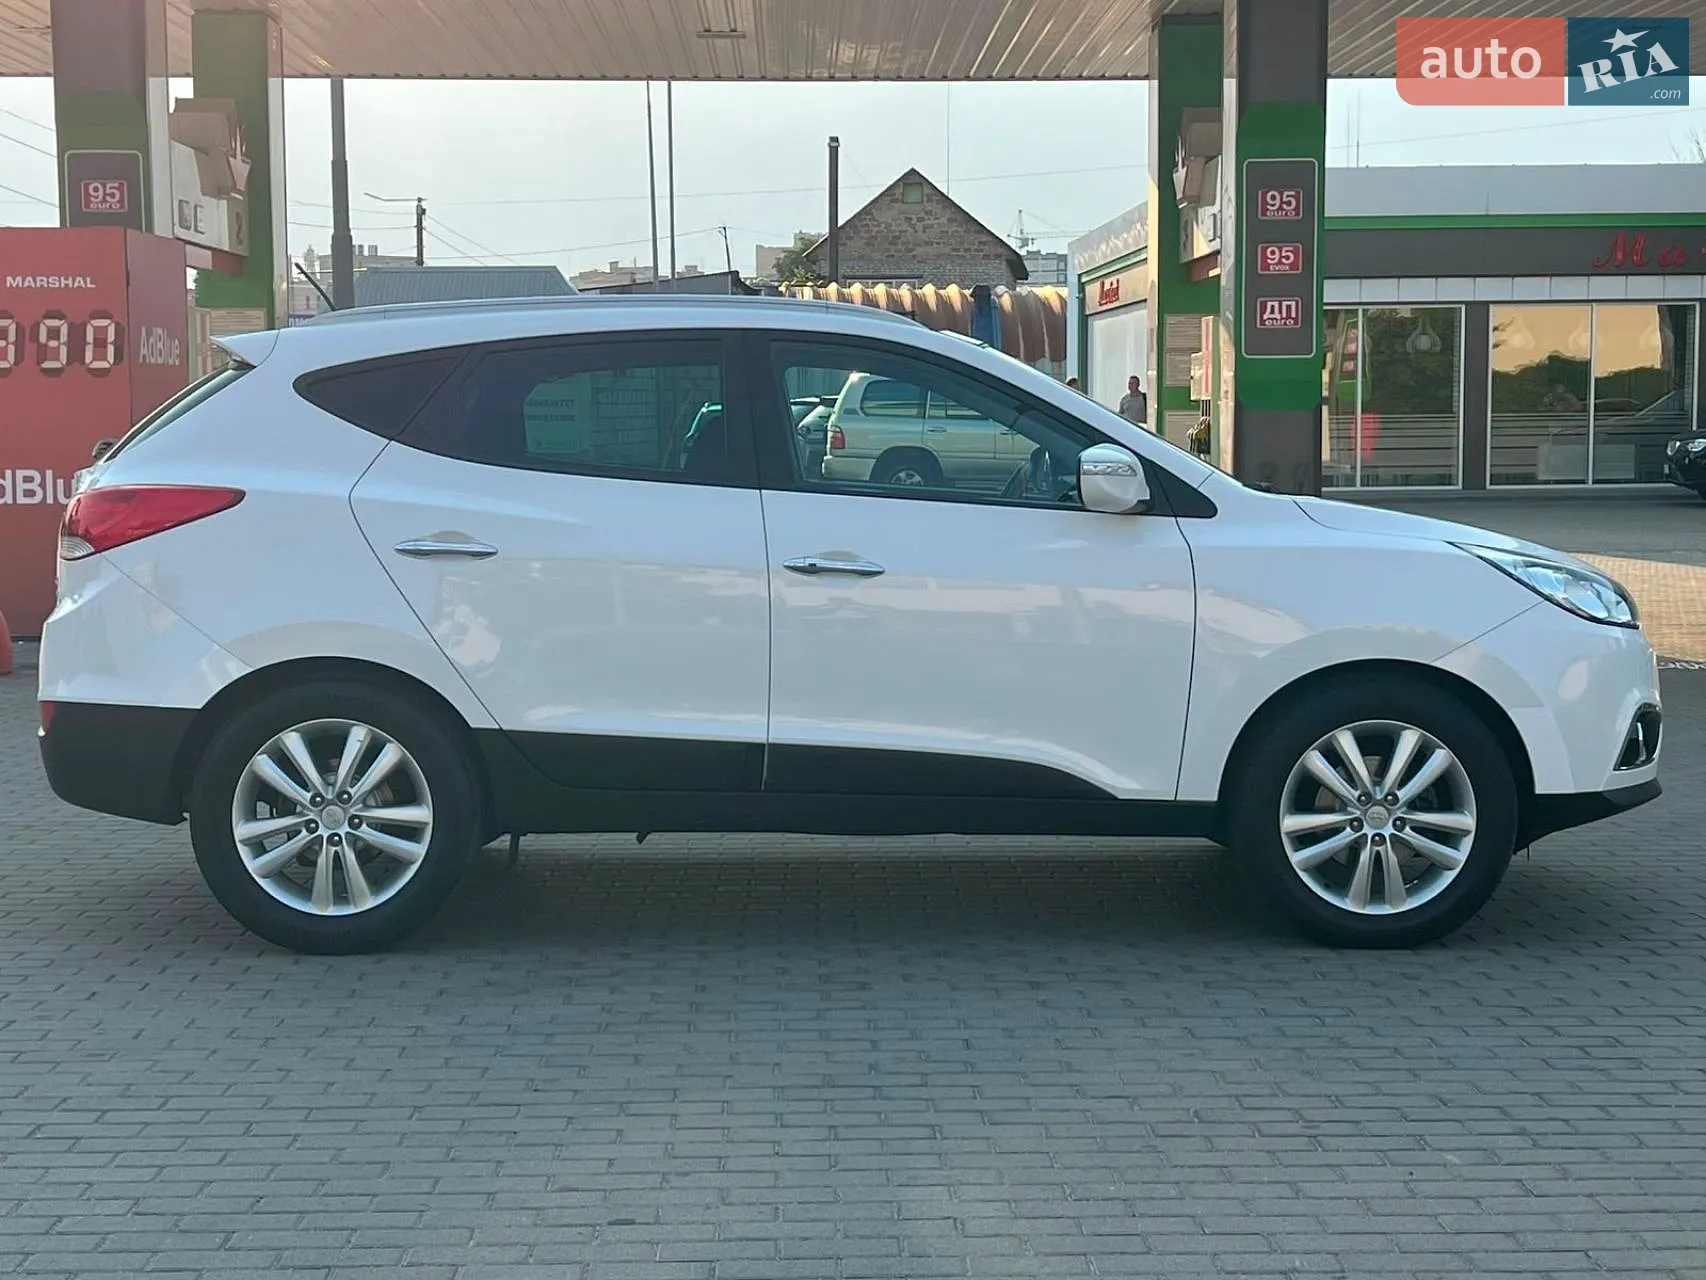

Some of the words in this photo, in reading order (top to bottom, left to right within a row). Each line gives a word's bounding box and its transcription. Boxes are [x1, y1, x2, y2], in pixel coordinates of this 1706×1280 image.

[89, 183, 120, 202] 95
[1266, 190, 1296, 210] 95
[1266, 246, 1294, 264] 95
[1593, 230, 1706, 269] Ma
[6, 276, 96, 288] MARSHAL
[1263, 301, 1296, 320] ДП
[139, 326, 181, 366] AdBlue
